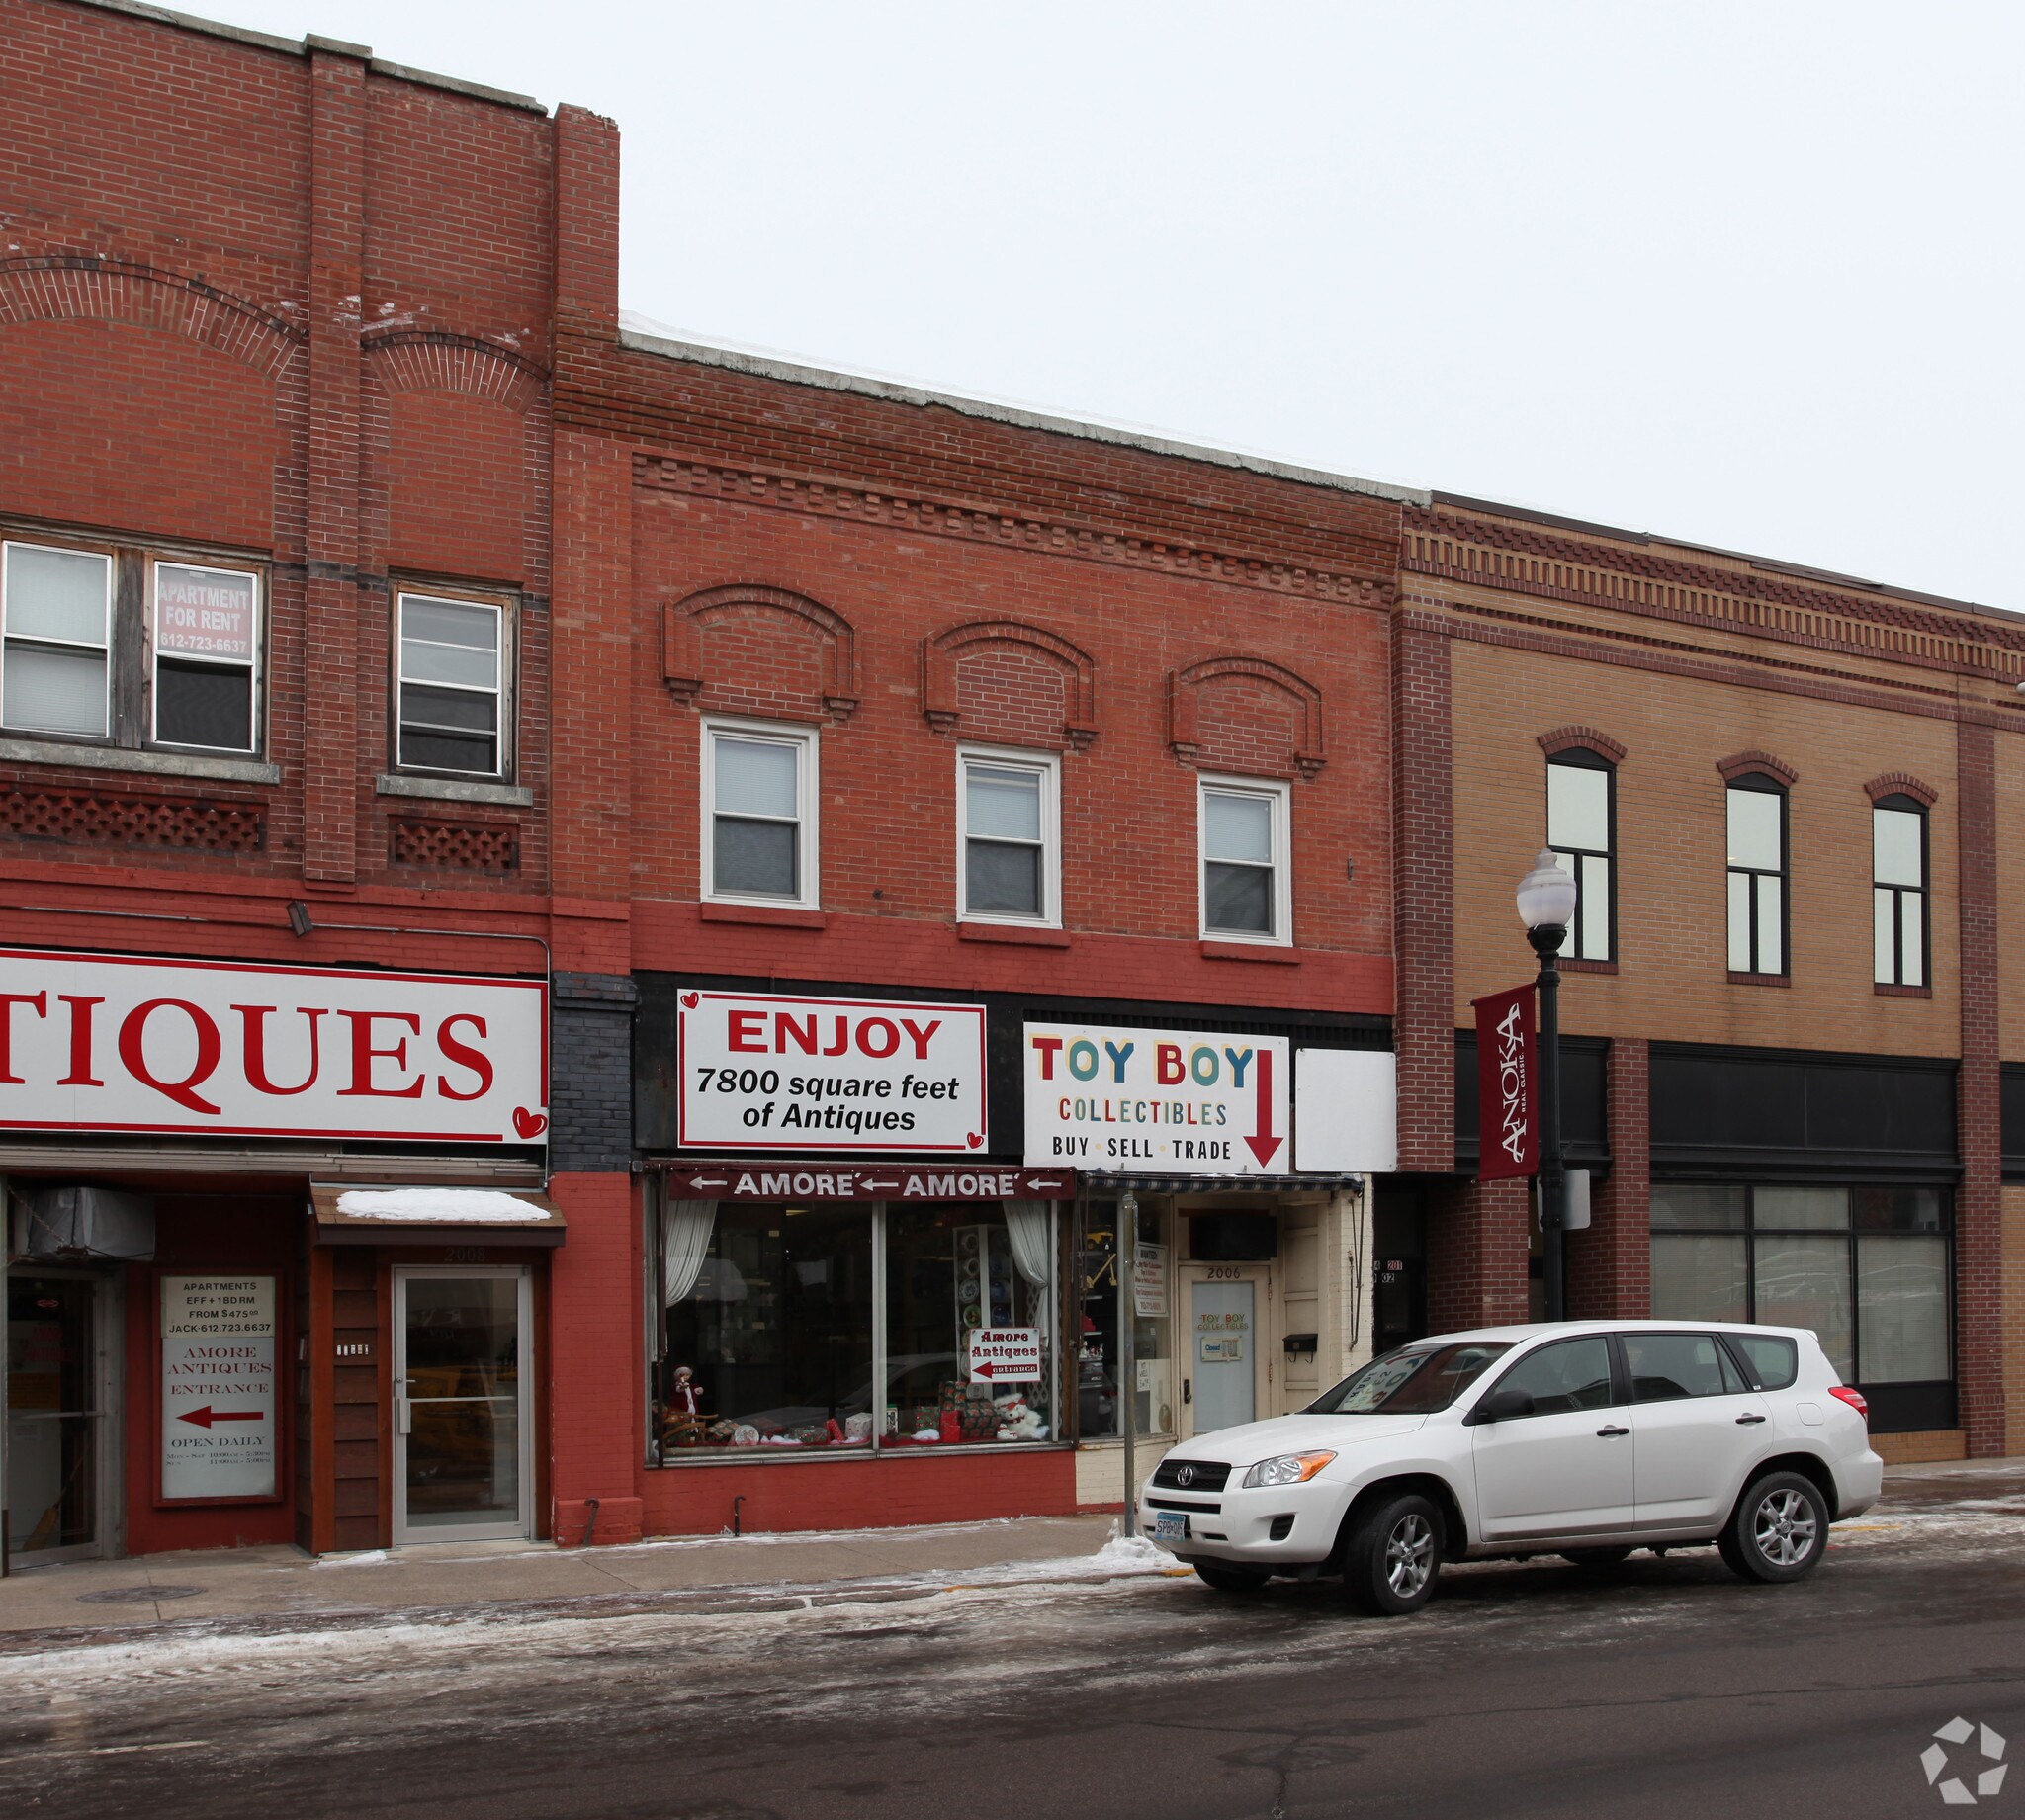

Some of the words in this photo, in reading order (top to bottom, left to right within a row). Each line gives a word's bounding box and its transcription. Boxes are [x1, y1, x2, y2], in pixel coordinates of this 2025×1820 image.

[158, 581, 249, 610] APARTMENT
[165, 605, 197, 628] FOR
[201, 609, 241, 632] RENT
[160, 632, 247, 653] 612-723-6637
[728, 1009, 942, 1060] ENJOY
[1029, 1034, 1134, 1083] TOY
[1154, 1041, 1253, 1088] BOY
[696, 1068, 779, 1095] 7800
[788, 1075, 891, 1103] square
[901, 1074, 959, 1100] feet
[1496, 1002, 1527, 1164] ANOKA
[743, 1103, 774, 1129] of
[781, 1104, 916, 1136] Antiques
[1058, 1097, 1227, 1126] COLLECTIBLES
[1053, 1136, 1088, 1156] BUY
[1107, 1138, 1153, 1158] SELL
[1172, 1139, 1231, 1160] TRADE
[1207, 1267, 1241, 1279] 2006
[183, 1282, 257, 1291] APARTMENTS
[1200, 1314, 1220, 1323] TOY
[1225, 1313, 1245, 1323] BOY
[981, 1331, 1029, 1342] Amore
[184, 1346, 257, 1359] AMORE
[972, 1346, 1038, 1359] Antiques
[167, 1362, 272, 1375] ANTIQUES
[171, 1383, 269, 1395] ENTRANCE
[171, 1437, 214, 1448] OPEN
[219, 1436, 265, 1446] DAILY
